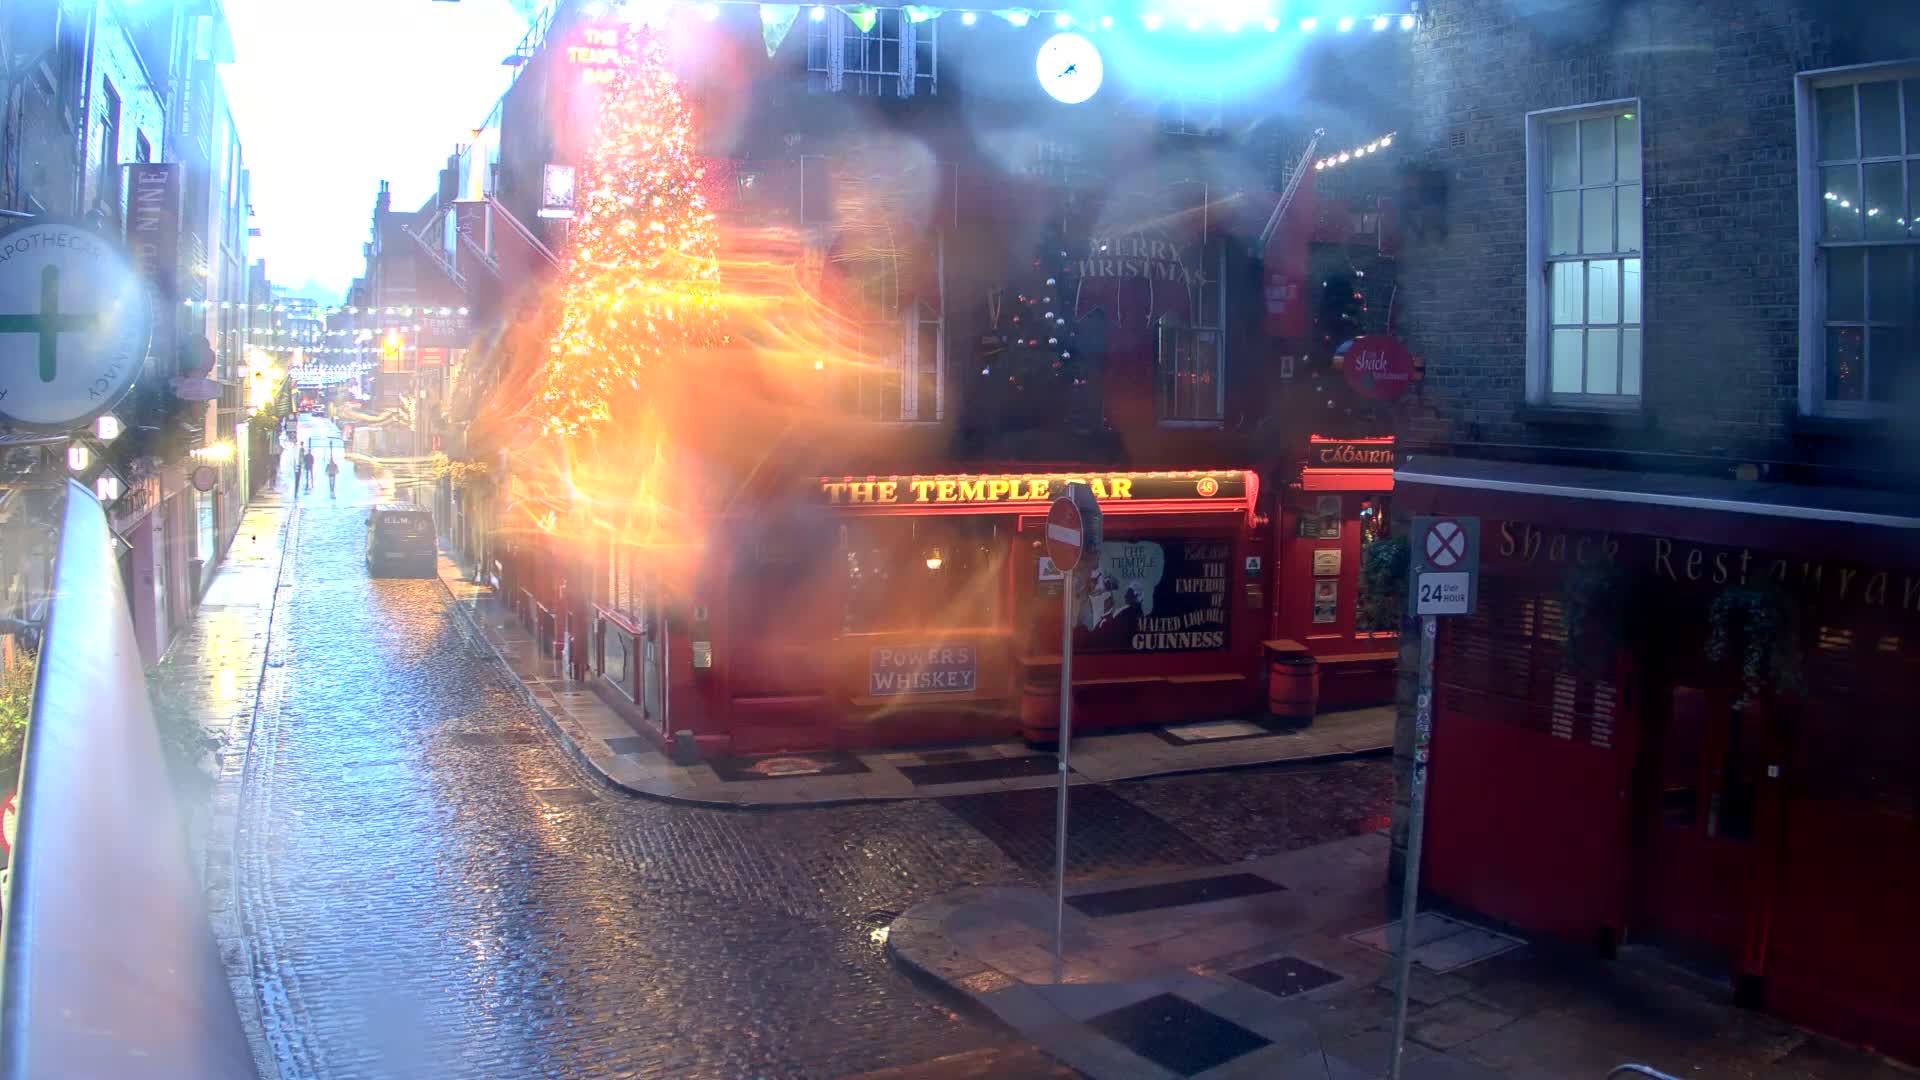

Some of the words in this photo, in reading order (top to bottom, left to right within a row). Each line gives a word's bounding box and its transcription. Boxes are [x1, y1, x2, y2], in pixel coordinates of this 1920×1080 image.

[137, 171, 168, 232] NINE
[1074, 258, 1207, 287] HRISTMAS
[824, 482, 897, 503] THE
[911, 479, 1050, 502] TEMPLE
[1065, 478, 1133, 499] AR
[1499, 519, 1620, 563] Shack
[1122, 545, 1146, 558] THE
[1111, 557, 1156, 568] TEMPLE
[1202, 562, 1225, 577] THE
[1121, 568, 1146, 578] BAR
[1175, 578, 1225, 593] EMPEROR
[1421, 584, 1443, 603] 24
[1443, 593, 1465, 602] HOUR
[1138, 616, 1181, 632] MALTED
[1131, 631, 1225, 650] GUINNESS
[879, 648, 969, 667] POWERS
[872, 671, 971, 690] WHISKEY
